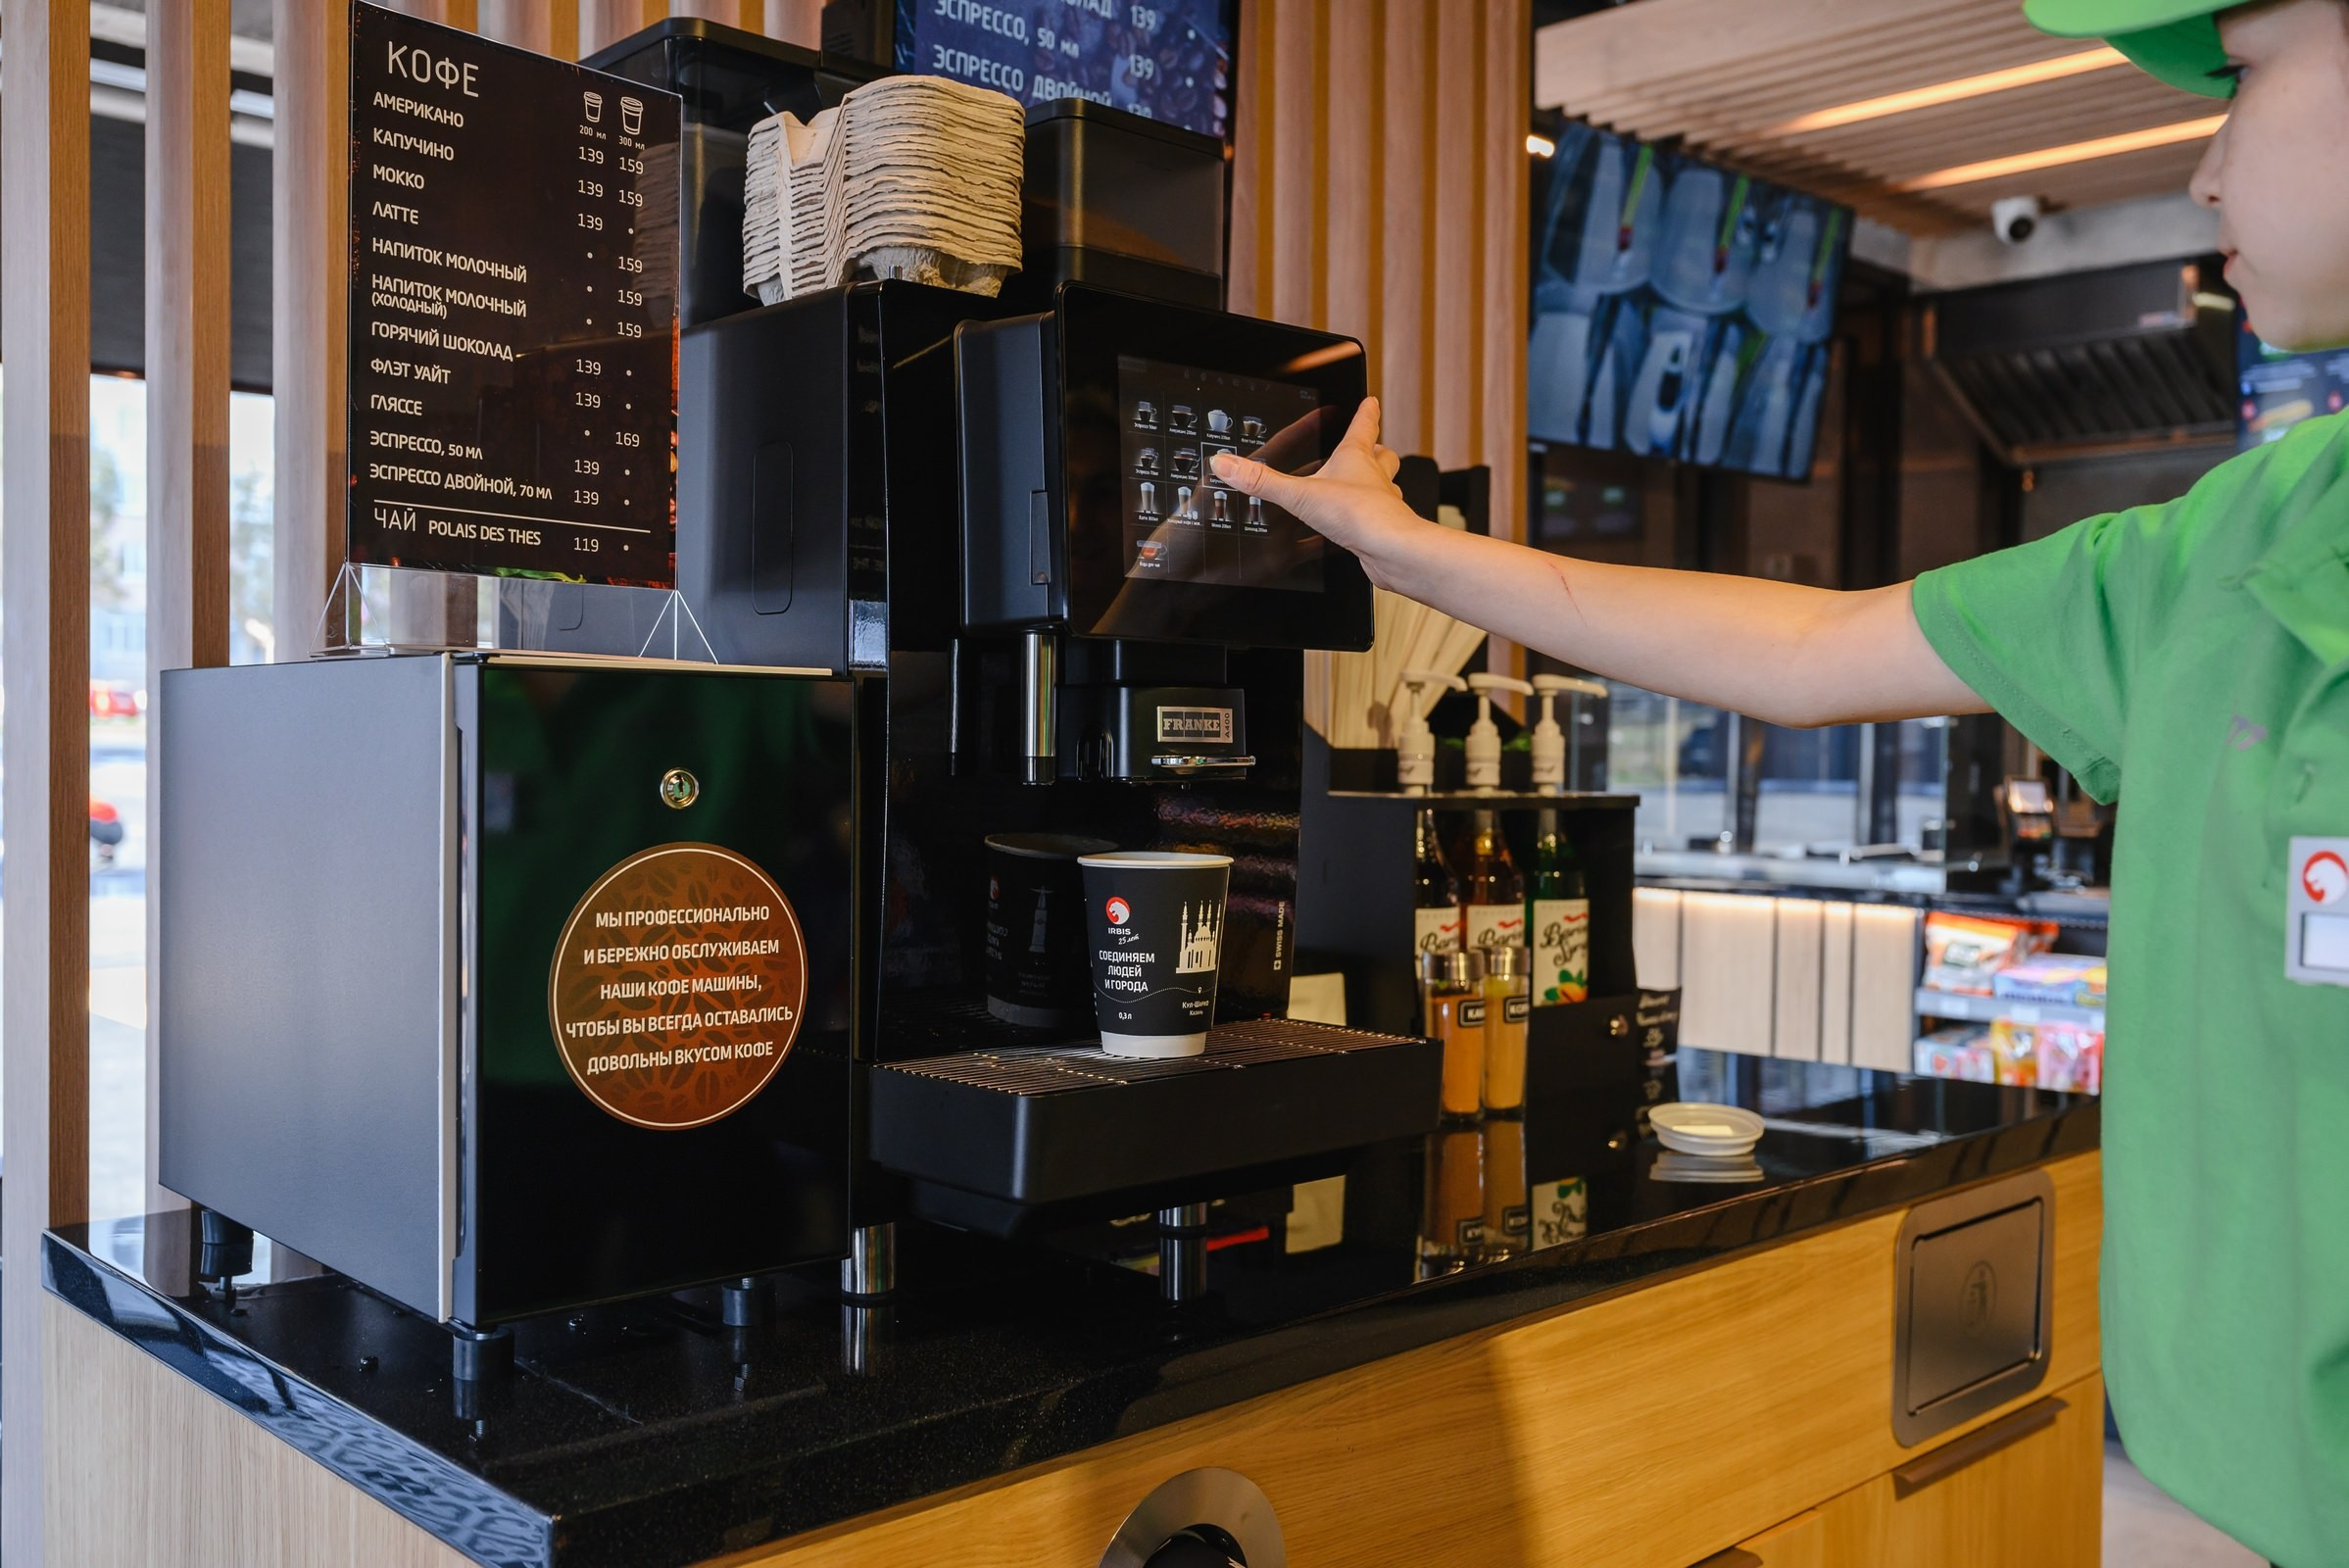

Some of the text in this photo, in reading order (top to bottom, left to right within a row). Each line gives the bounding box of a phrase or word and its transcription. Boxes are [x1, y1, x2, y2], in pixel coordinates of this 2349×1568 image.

[1131, 5, 1156, 31] 139
[934, 0, 1029, 46] ЭСПРЕССО,
[1038, 27, 1054, 50] 50
[1129, 54, 1153, 79] 139
[387, 41, 479, 98] КОФЕ
[933, 44, 1024, 92] ЭСПРЕССО
[373, 91, 465, 127] АМЕРИКАНО
[579, 125, 594, 137] 200
[619, 135, 633, 147] 300
[373, 127, 455, 161] КАПУЧИНО
[579, 146, 644, 174] 139 159
[373, 165, 424, 189] МОККО
[578, 180, 643, 207] 139 159
[373, 202, 418, 225] ЛАТТЕ
[578, 214, 604, 231] 139
[372, 238, 527, 282] НАПИТОК МОЛОЧНЫЙ
[618, 256, 643, 273] 159
[371, 292, 448, 319] (ХОЛОДНЫЙ)
[372, 274, 526, 318] НАПИТОК МОЛОЧНЫЙ
[617, 289, 643, 307] 159
[371, 321, 514, 362] ГОРЯЧИЙ ШОКОЛАД
[617, 321, 642, 339] 159
[371, 358, 451, 384] ФЛЭТ УАЙТ
[576, 359, 602, 375] 139
[370, 394, 422, 416] ГЛЯССЕ
[575, 392, 601, 409] 139
[370, 430, 445, 457] ЭСПРЕССО,
[449, 444, 463, 458] 50
[615, 431, 640, 448] 169
[574, 459, 600, 476] 139
[369, 464, 441, 487] ЭСПРЕССО
[444, 471, 516, 498] ДВОЙНОЙ,
[520, 484, 534, 498] 70
[573, 489, 599, 506] 139
[374, 508, 541, 546] ЧАЙ POLAIS DES THES
[574, 537, 599, 553] 119
[1163, 718, 1220, 731] FRANKE
[596, 906, 769, 927] МЫ ПРОФЕССИОНАЛЬНО
[584, 940, 779, 964] И БЕРЕЖНО ОБСЛУЖИВАЕМ
[1275, 929, 1284, 957] SWISS
[1100, 951, 1154, 963] СОЕДИНЯЕМ
[1108, 964, 1142, 978] ЛЮДЕЙ
[601, 975, 762, 1000] НАШИ КОФЕ МАШИНЫ,
[1104, 979, 1149, 993] И ГОРОДА
[566, 1005, 794, 1039] ЧТОБЫ ВЫ ВСЕГДА ОСТАВАЛИСЬ
[587, 1041, 774, 1076] ДОВОЛЬНЫ ВКУСОМ КОФЕ
